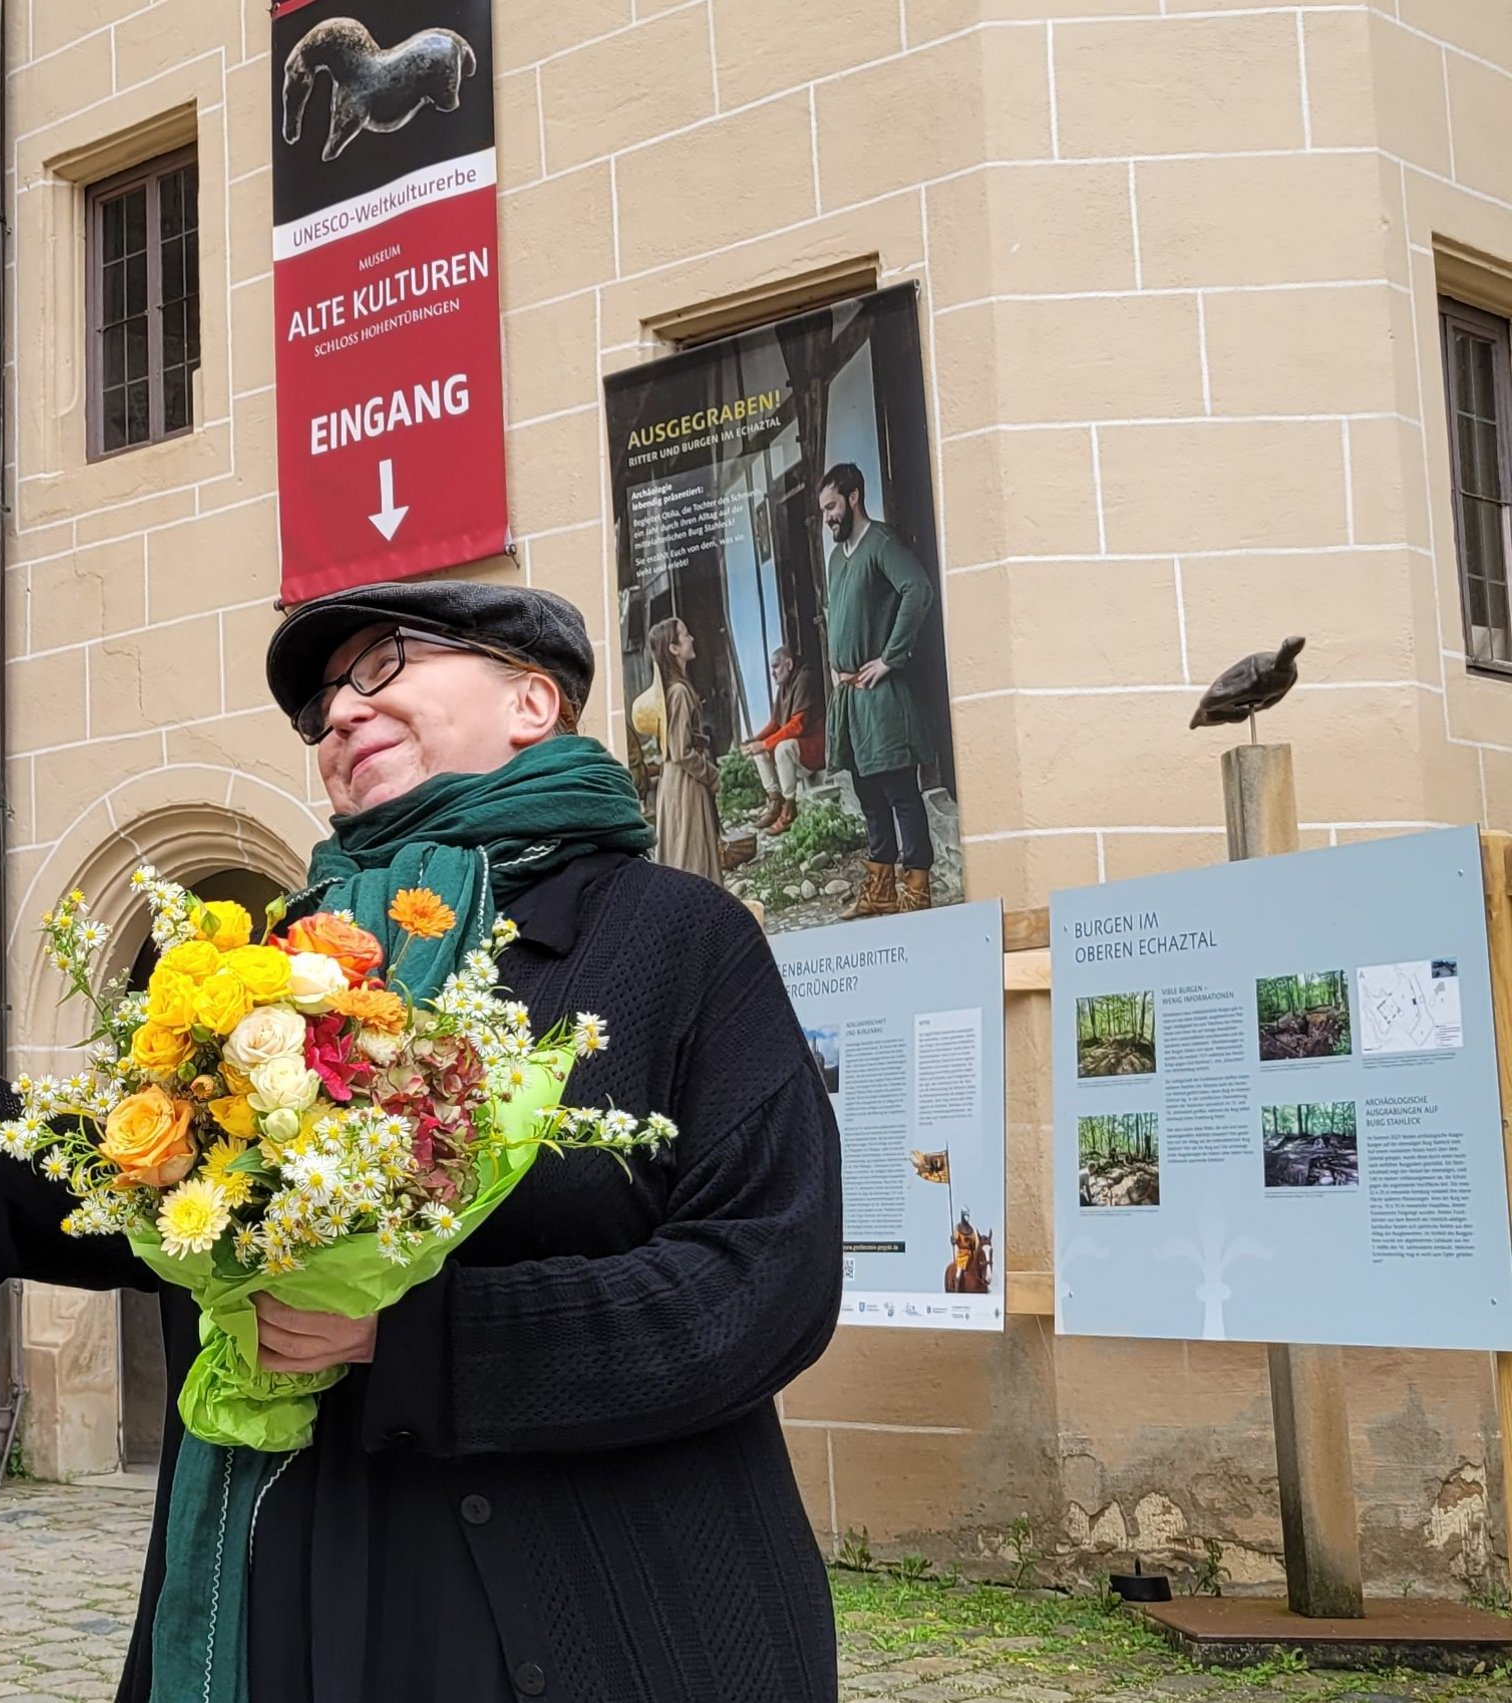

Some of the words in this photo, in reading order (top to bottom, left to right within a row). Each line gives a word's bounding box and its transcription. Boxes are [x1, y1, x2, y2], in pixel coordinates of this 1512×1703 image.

[292, 168, 478, 247] UNESCO-Weltkulturerbe
[358, 244, 402, 272] MUSEUM
[287, 295, 346, 342] ALTE
[353, 247, 489, 320] KULTUREN
[314, 332, 359, 358] SCHLOSS
[361, 298, 461, 342] HOHENTÜBINGEN
[310, 373, 470, 456] EINGANG
[627, 388, 782, 451] AUSGEGRABEN!
[628, 450, 658, 468] RITTER
[659, 445, 680, 460] UND
[681, 434, 719, 452] BURGEN
[720, 430, 735, 442] IM
[736, 416, 782, 438] ECHAZTAL
[631, 483, 673, 500] Archäologie
[631, 497, 663, 512] lebendig
[663, 486, 704, 505] präsentiert:
[1074, 914, 1134, 939] BURGEN
[1138, 911, 1160, 931] IM
[1074, 941, 1134, 964] OBEREN
[1138, 930, 1218, 956] ECHAZTAL
[1161, 986, 1177, 996] VIELE
[1178, 985, 1203, 994] BURGEN
[1161, 996, 1183, 1006] WENIG
[1183, 991, 1235, 1003] INFORMATIONEN
[1365, 1095, 1428, 1106] ARCHÄOLOGISCHE
[1365, 1106, 1423, 1117] AUSGRABUNGEN
[1366, 1118, 1385, 1128] BURG
[1386, 1117, 1422, 1127] STAHLECK
